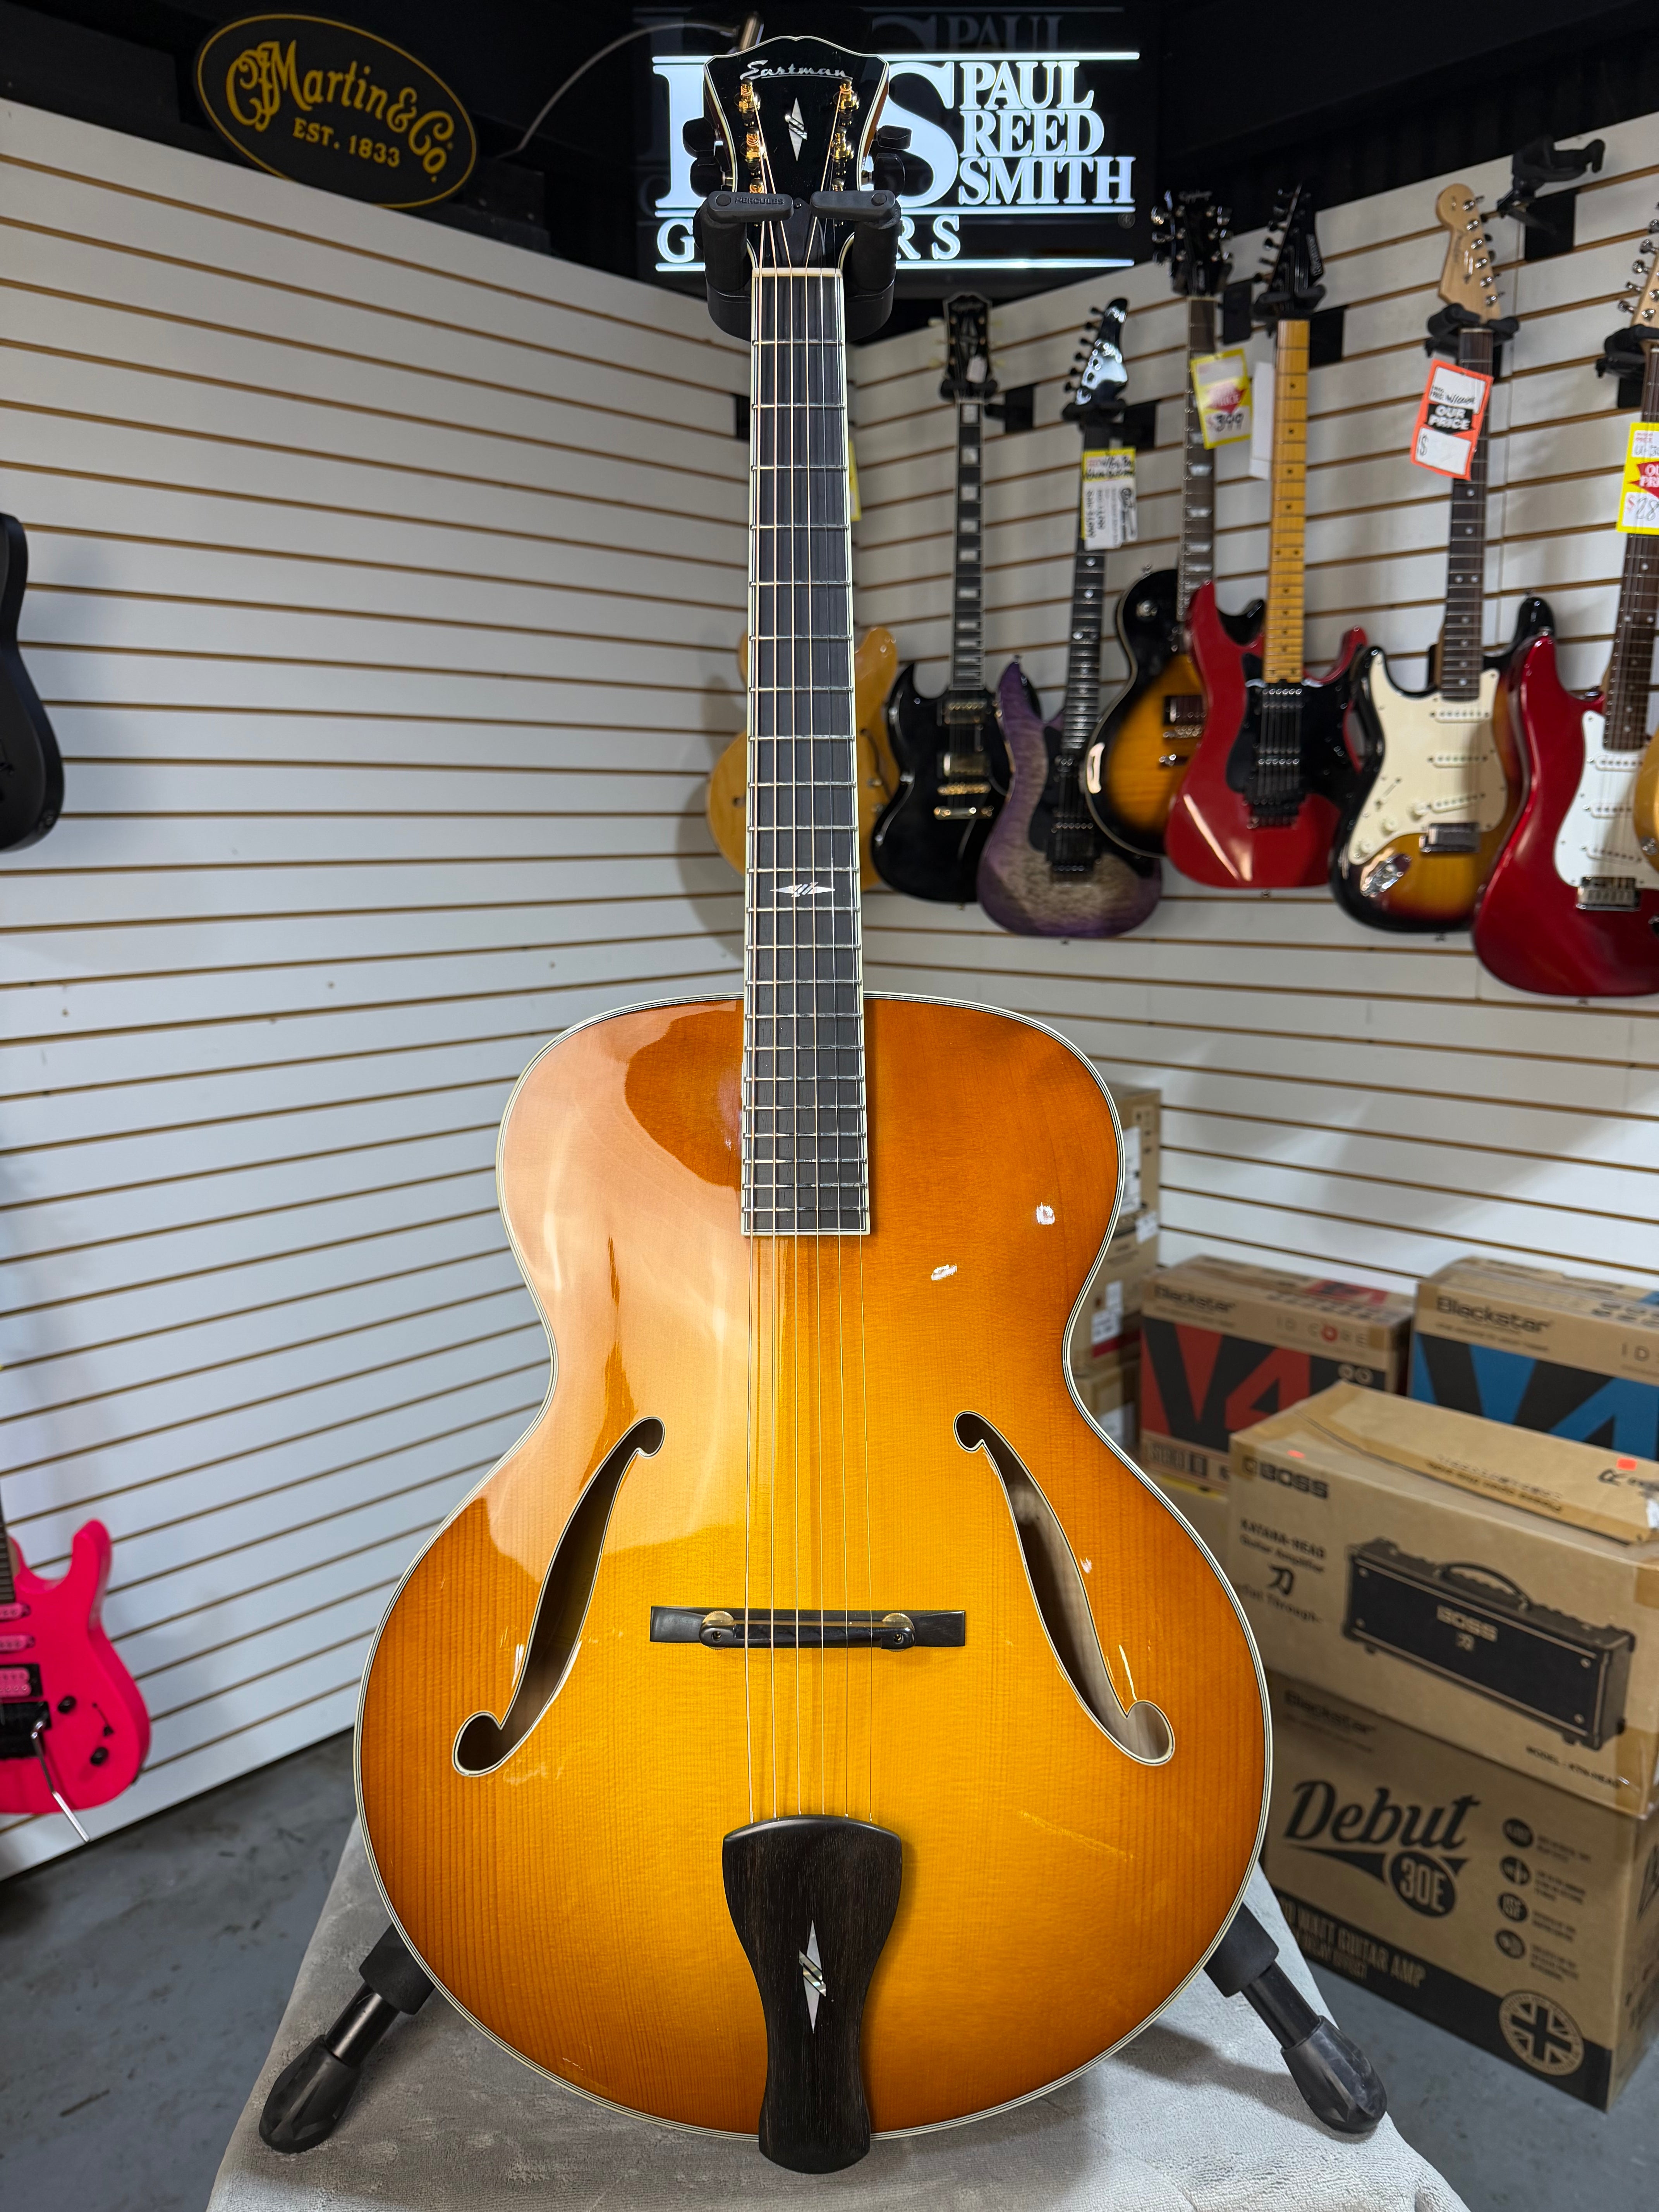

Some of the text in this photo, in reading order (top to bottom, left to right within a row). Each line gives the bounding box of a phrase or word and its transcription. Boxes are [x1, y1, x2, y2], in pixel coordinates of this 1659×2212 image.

[740, 60, 853, 80] Eastman
[959, 61, 1094, 109] PAUL
[293, 117, 400, 168] EST. 1833
[959, 110, 1105, 157] REED
[958, 156, 1137, 206] SMITH
[735, 197, 785, 206] HERCULES
[1427, 414, 1471, 430] PRICE
[1435, 405, 1466, 419] OUR
[1419, 434, 1429, 456] $
[1436, 1295, 1552, 1333] Blackstar
[1259, 1460, 1329, 1499] BOSS
[1436, 1605, 1498, 1642] BOSS
[1284, 1780, 1480, 1850] Debut
[1399, 1858, 1446, 1914] 30E
[1337, 1926, 1389, 1974] GUITAR
[1390, 1954, 1427, 1989] AMP
